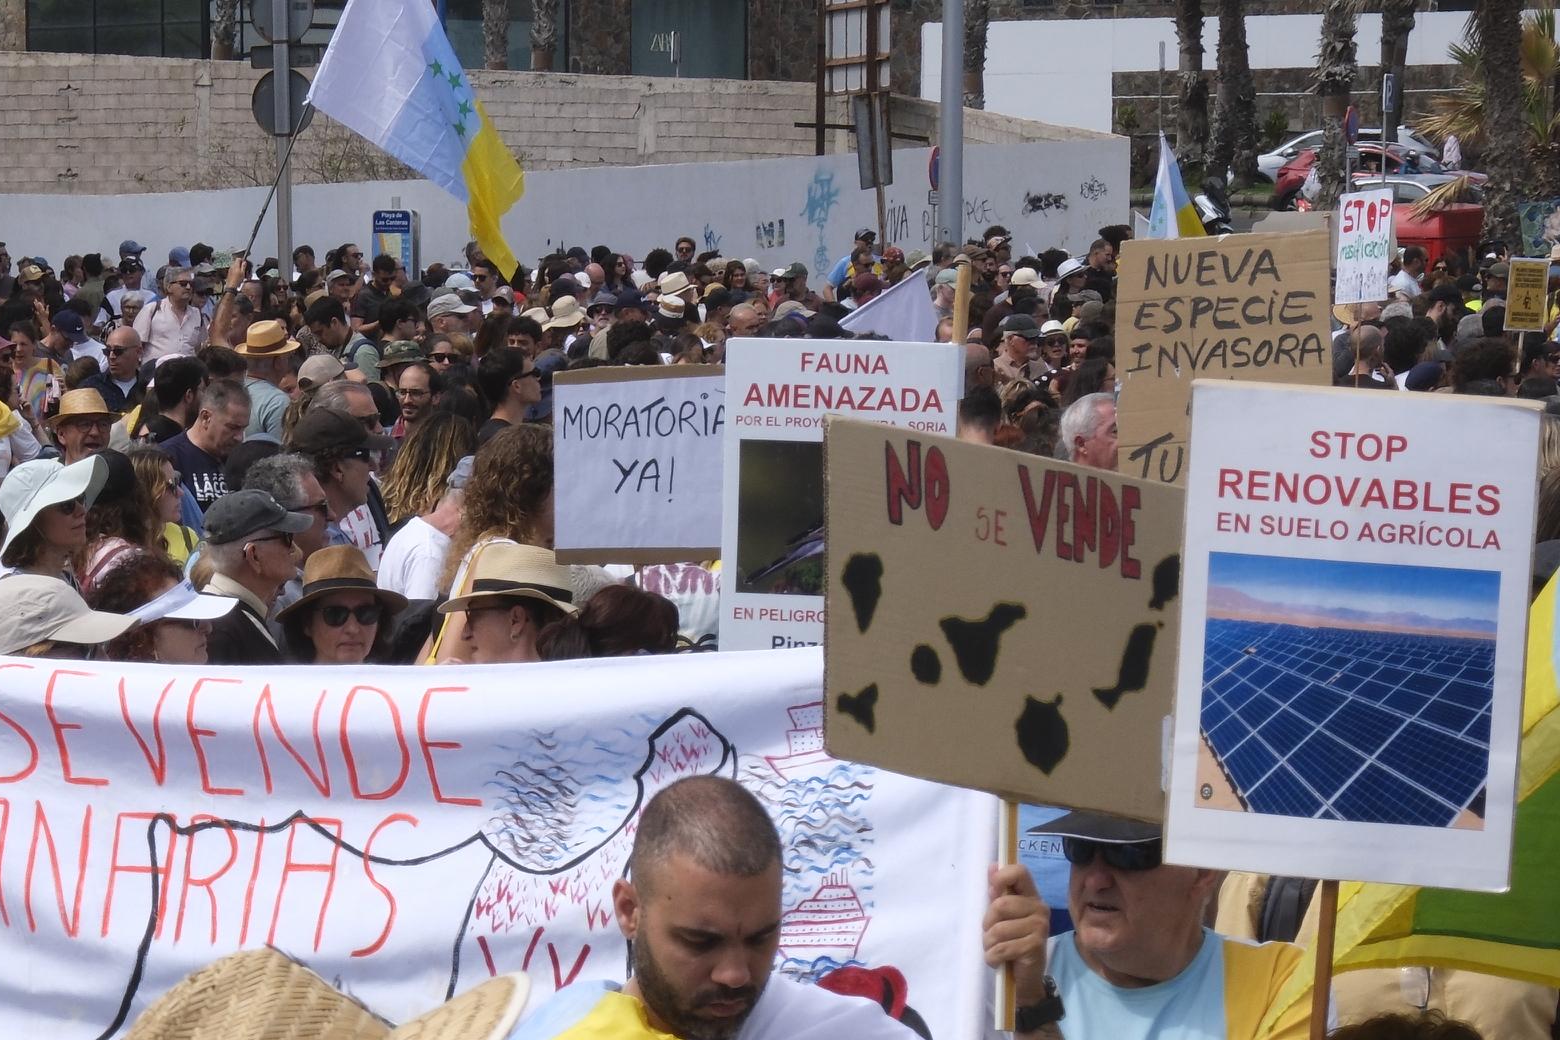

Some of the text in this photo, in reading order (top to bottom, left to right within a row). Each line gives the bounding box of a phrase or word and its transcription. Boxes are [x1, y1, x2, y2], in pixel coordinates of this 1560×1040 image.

[1343, 199, 1391, 233] STOP
[1144, 248, 1282, 291] NUEVA
[800, 352, 889, 375] FAUNA
[1125, 333, 1326, 378] INVASORA
[742, 383, 944, 414] AMENAZADA
[735, 415, 762, 427] POR
[766, 416, 781, 427] EL
[1309, 430, 1409, 462] STOP
[612, 456, 676, 503] YA!
[1218, 468, 1502, 517] RENOVABLES
[885, 439, 1142, 580] NO SE VENDE
[1216, 512, 1502, 551] EN SUELO AGRÍCOLA
[734, 607, 754, 620] EN
